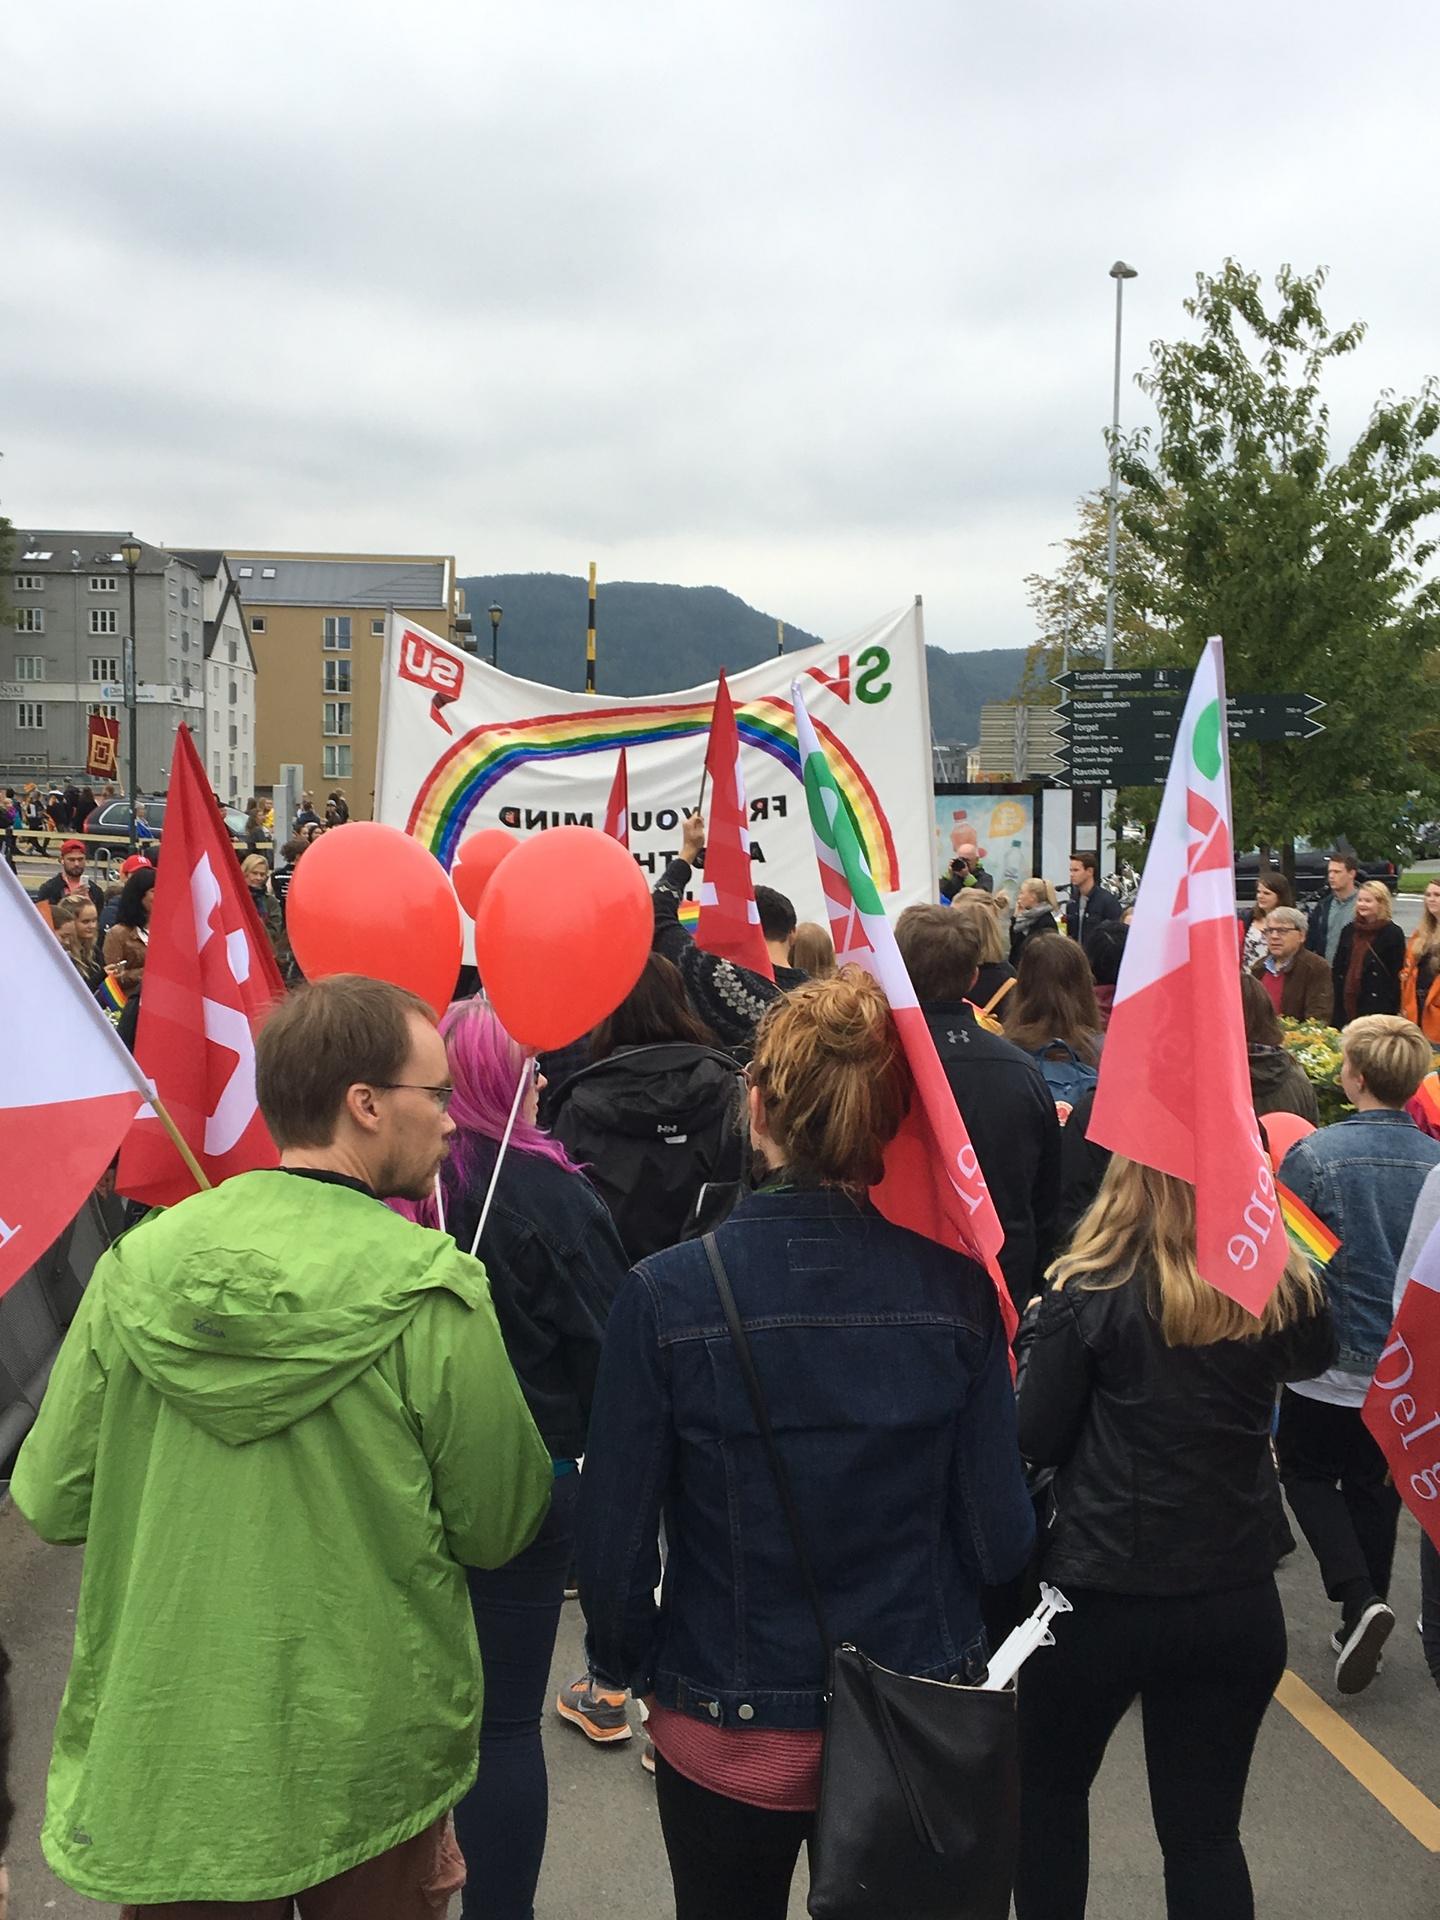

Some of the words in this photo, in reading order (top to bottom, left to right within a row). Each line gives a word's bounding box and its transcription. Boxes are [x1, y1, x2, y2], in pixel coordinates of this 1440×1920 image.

[1074, 672, 1141, 681] Turistinformasjon
[1073, 701, 1131, 709] Nidarosdomen
[1072, 723, 1100, 733] Torget
[1072, 745, 1099, 754] Gamle
[1100, 745, 1124, 755] bybru
[1072, 767, 1110, 776] Ravnkloa
